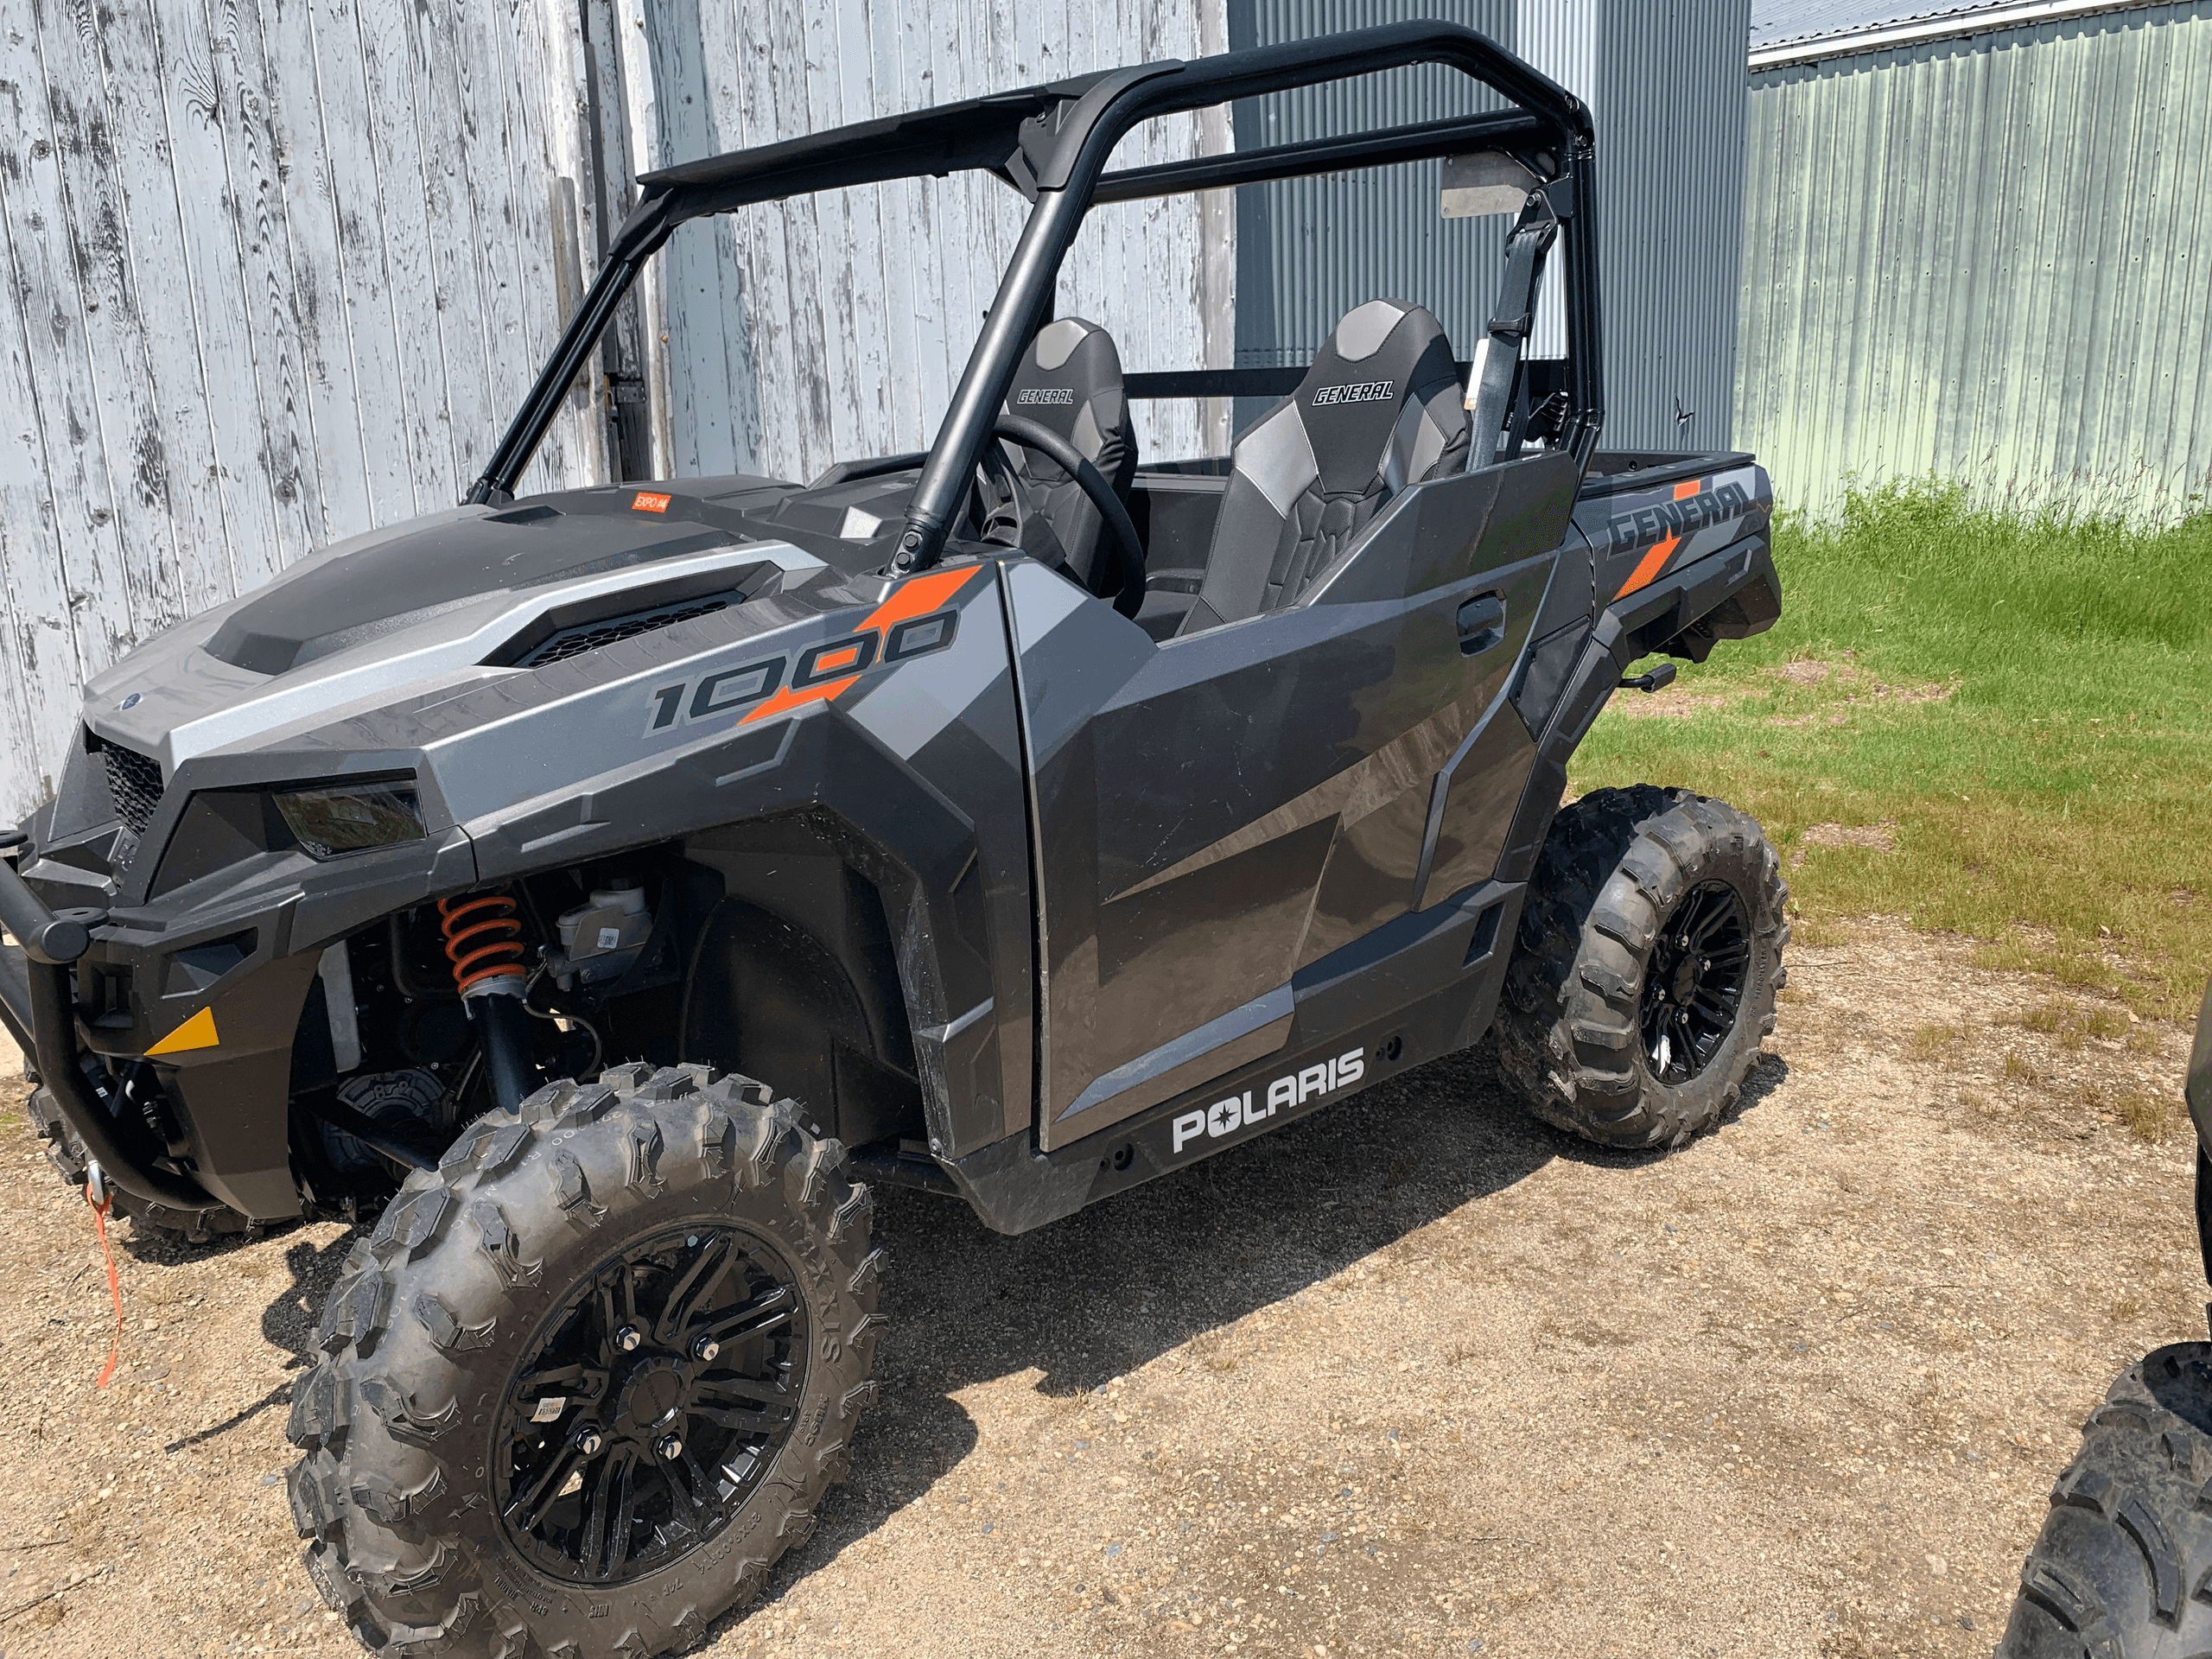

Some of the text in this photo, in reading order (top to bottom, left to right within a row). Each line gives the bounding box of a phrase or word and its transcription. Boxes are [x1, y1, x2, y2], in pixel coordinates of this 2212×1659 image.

[1016, 388, 1074, 405] GENERAL
[1312, 380, 1395, 407] GENERAL
[635, 496, 658, 508] EXPO
[1606, 480, 1754, 560] GENERAL
[647, 606, 958, 734] 1000
[1173, 1046, 1364, 1154] POLARIS
